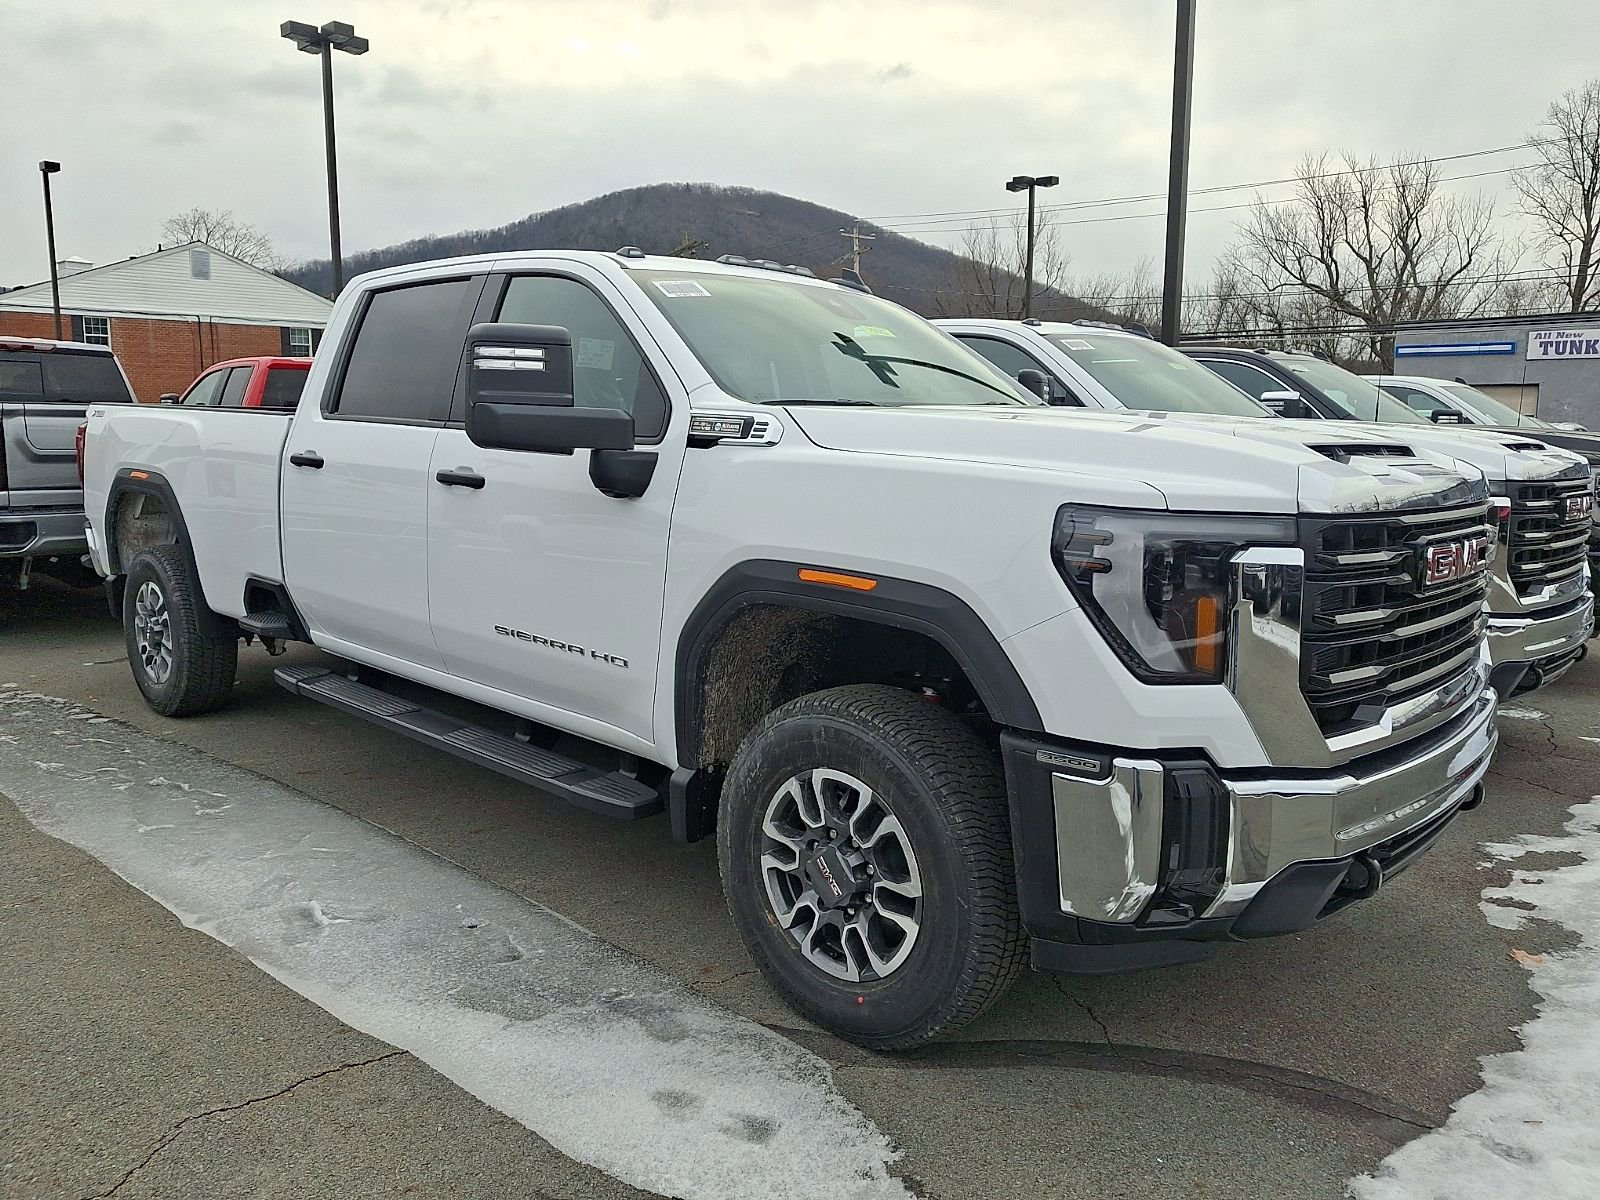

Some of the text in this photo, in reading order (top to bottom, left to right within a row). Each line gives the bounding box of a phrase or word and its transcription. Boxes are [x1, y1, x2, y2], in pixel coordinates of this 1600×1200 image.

[1534, 331, 1584, 340] All New
[1539, 339, 1600, 356] TUNK
[1426, 537, 1487, 585] GMC
[494, 624, 629, 668] SIERRA HD
